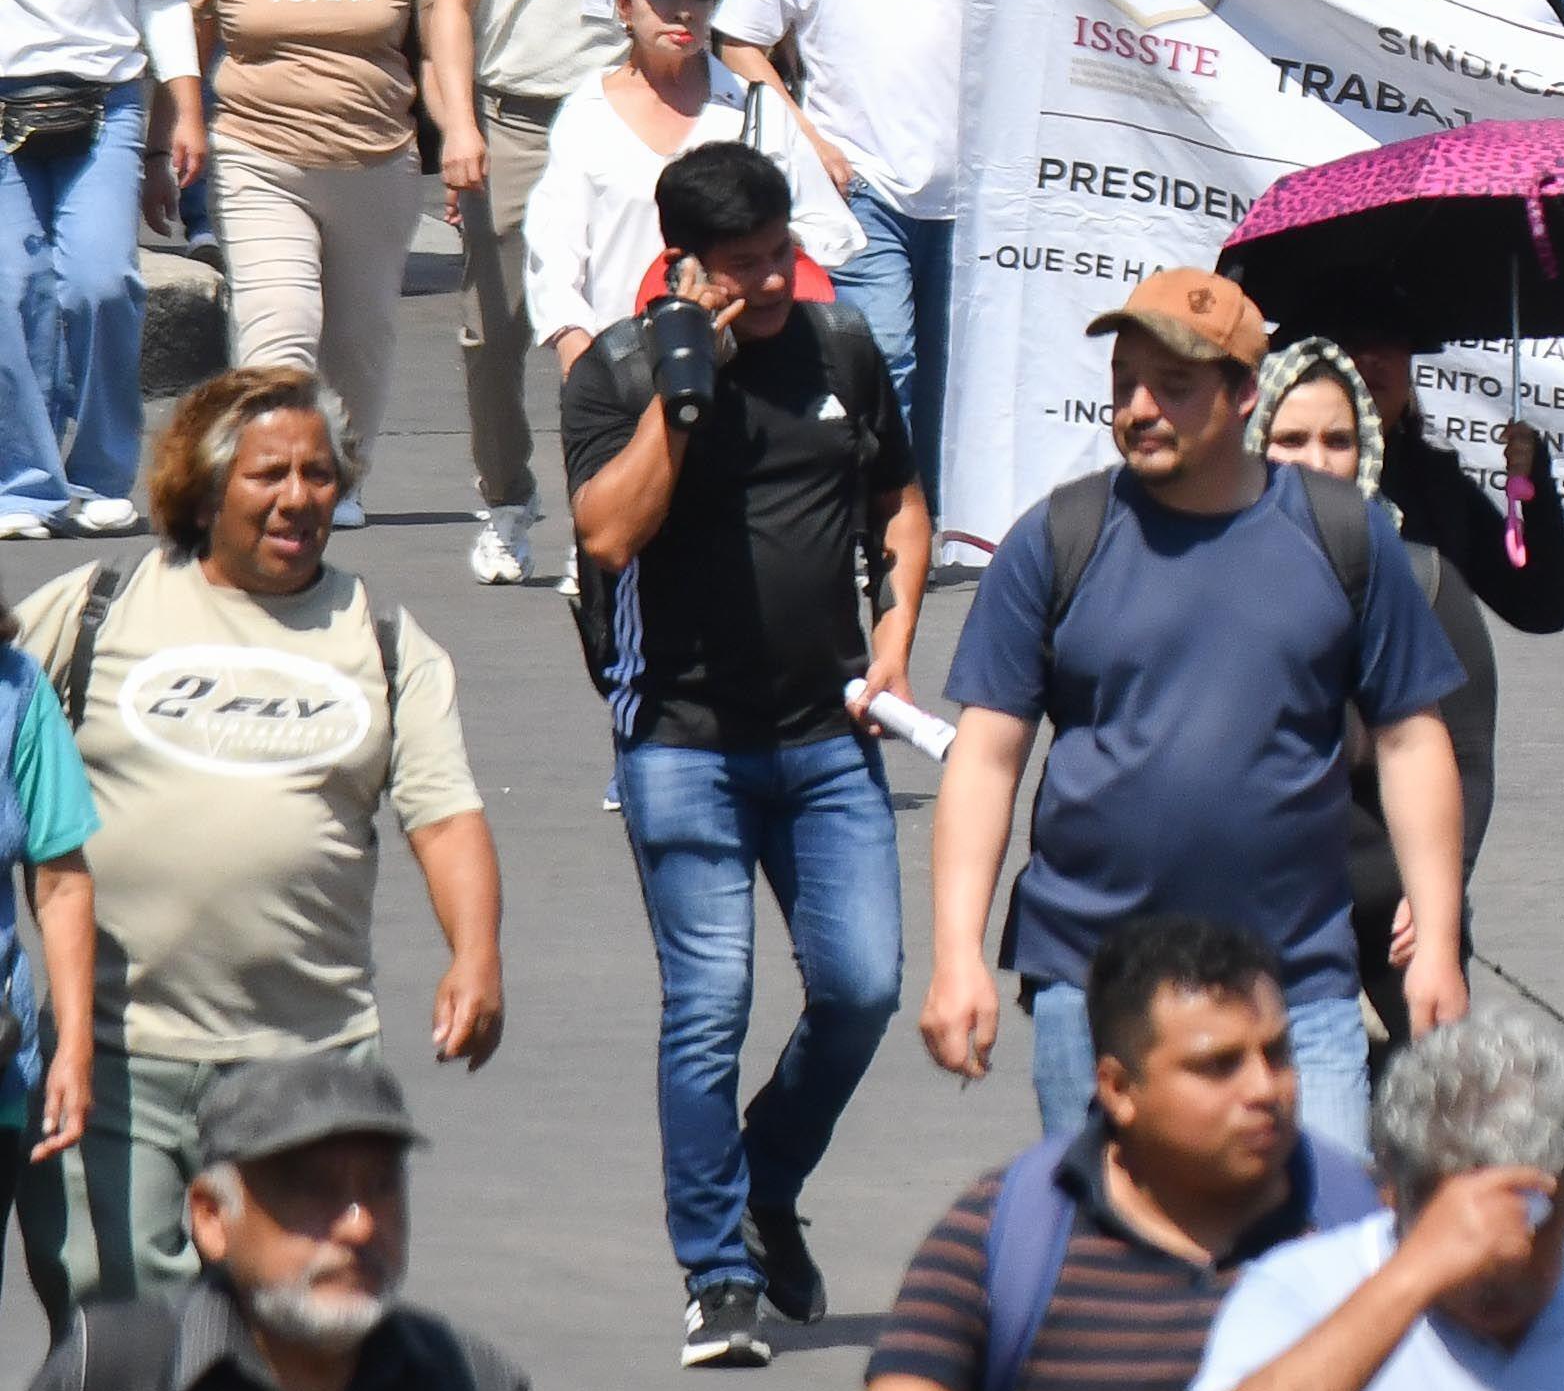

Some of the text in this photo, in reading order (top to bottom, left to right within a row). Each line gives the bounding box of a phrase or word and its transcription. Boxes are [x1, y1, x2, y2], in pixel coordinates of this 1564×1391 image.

[1073, 15, 1219, 77] ISSSTE
[1072, 252, 1114, 280] SE
[146, 674, 340, 720] 2 FLY
